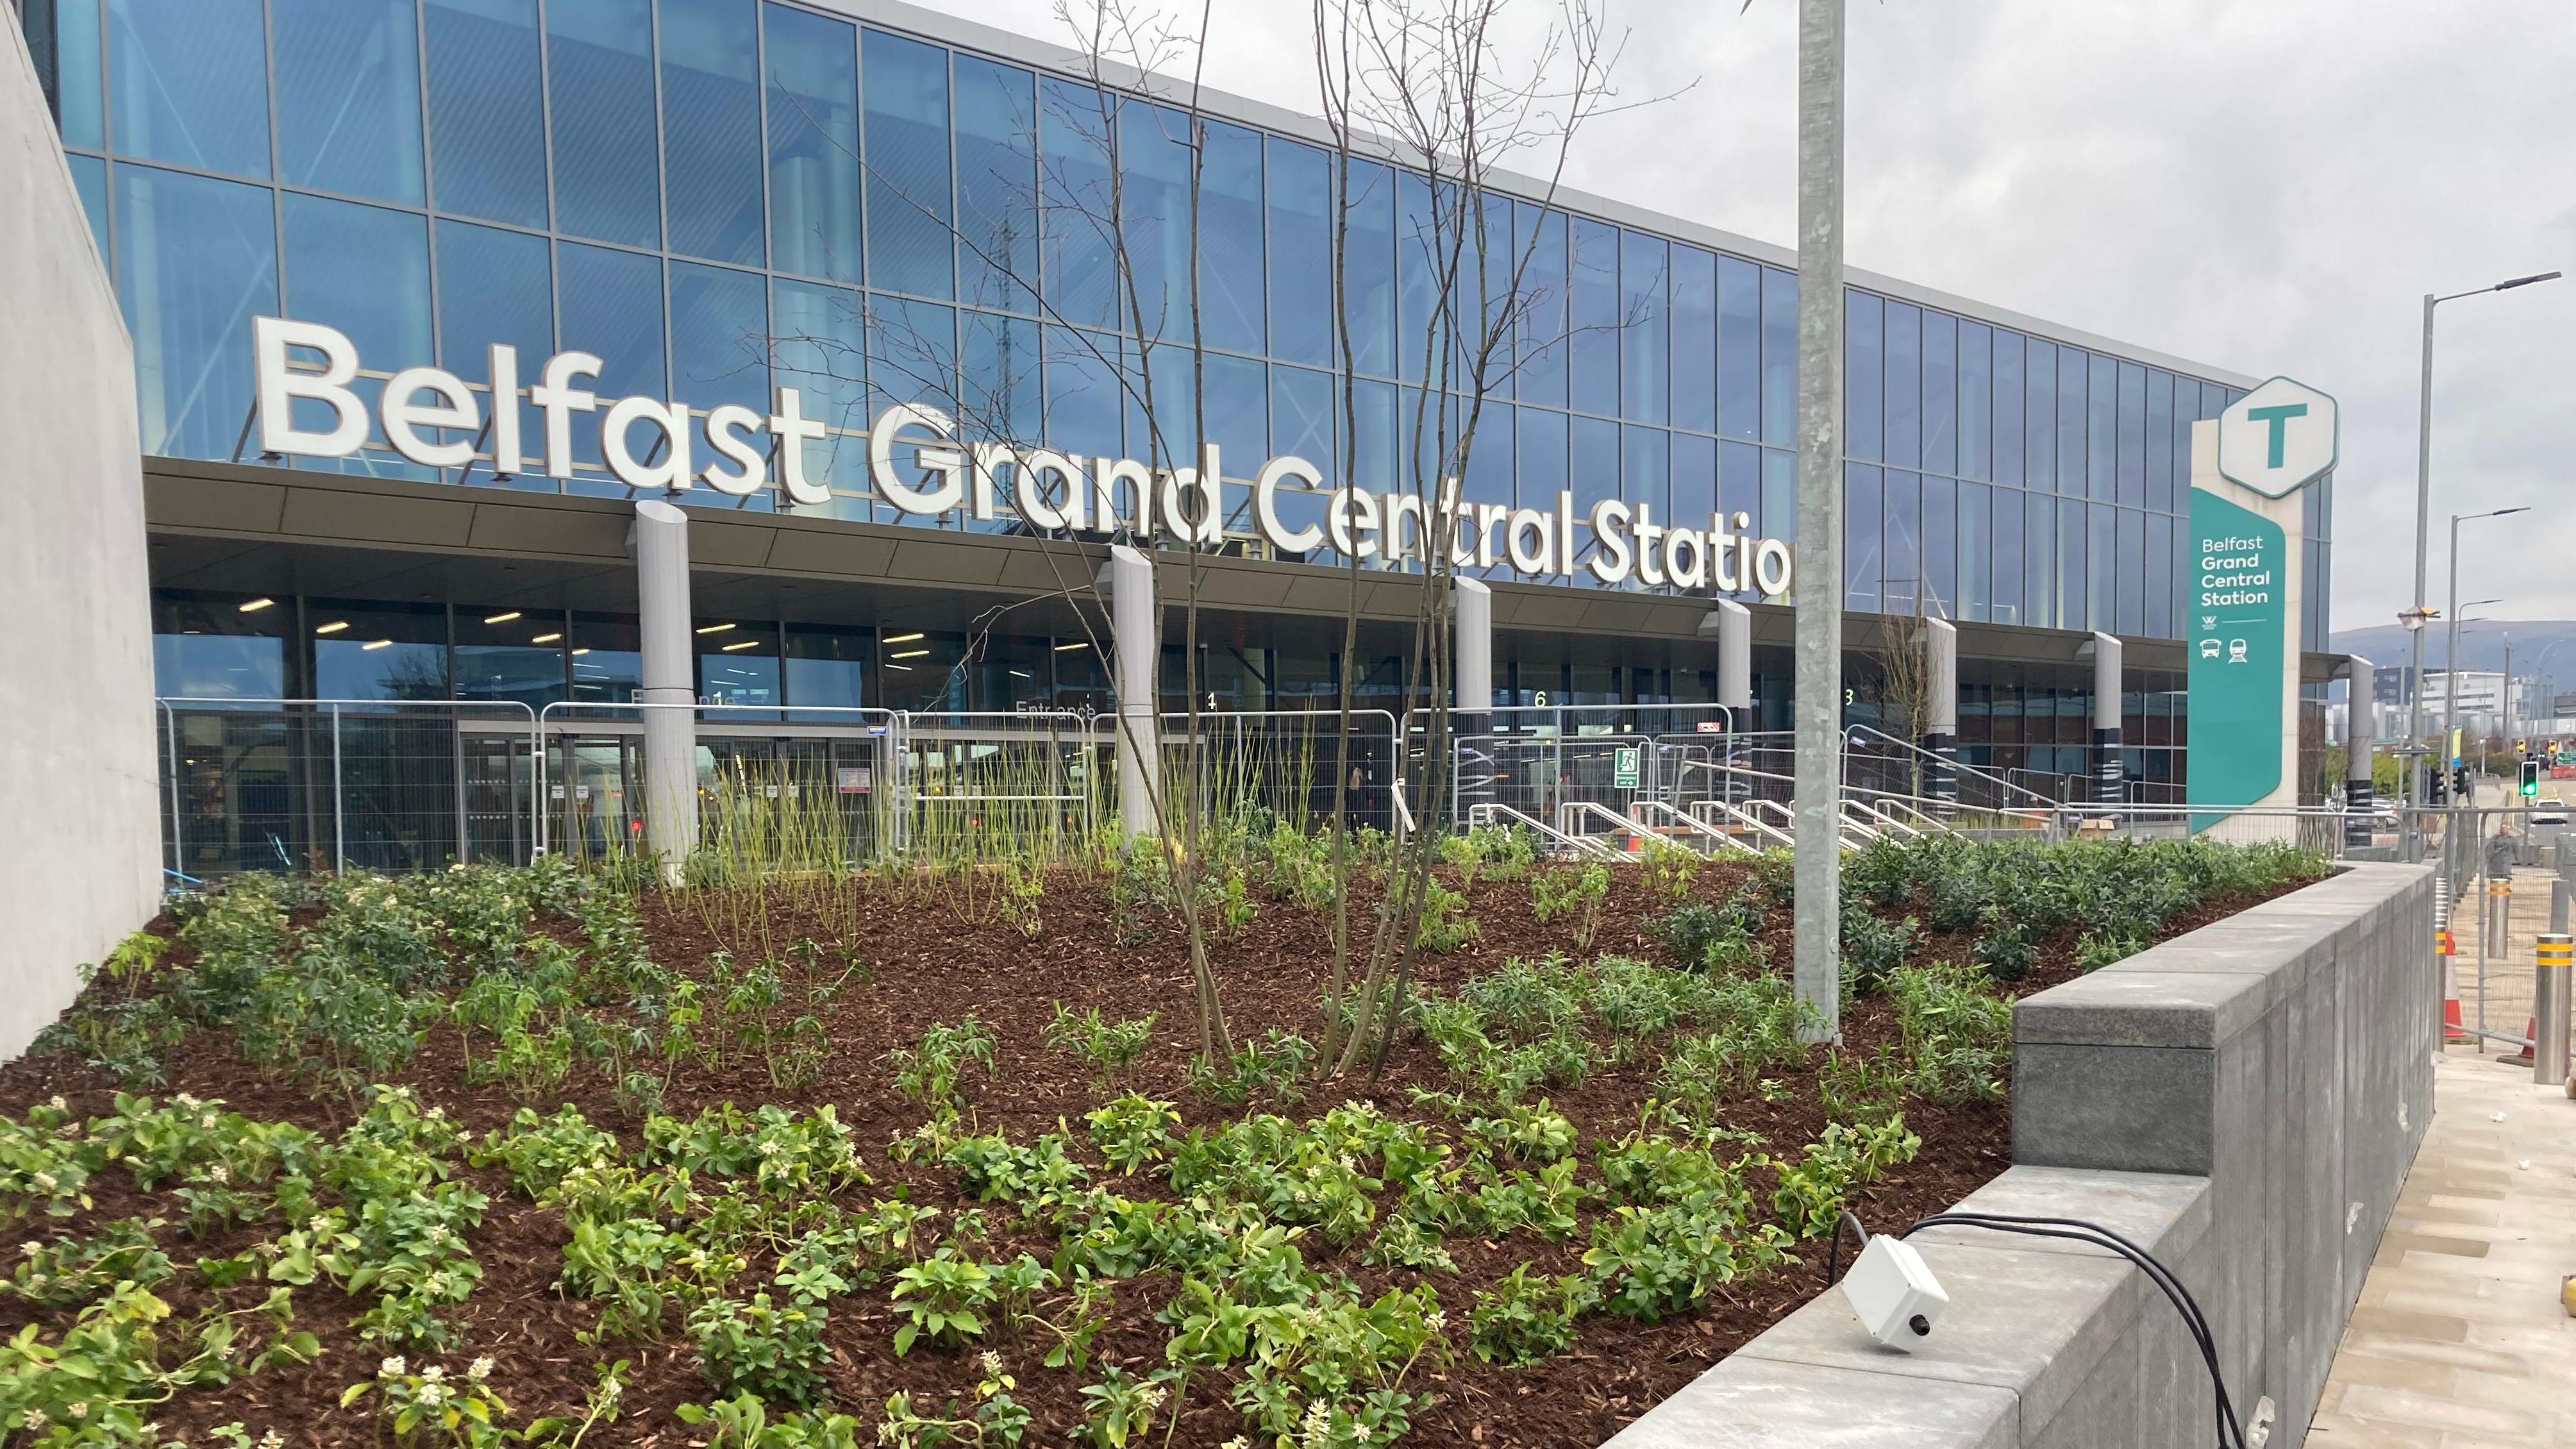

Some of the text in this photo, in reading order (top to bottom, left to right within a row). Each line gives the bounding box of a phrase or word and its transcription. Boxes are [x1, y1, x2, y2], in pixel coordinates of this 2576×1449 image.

[2248, 403, 2307, 469] T
[253, 316, 1797, 596] Belfast Grand Central Statio
[2202, 536, 2263, 553] Belfast
[2202, 553, 2259, 571] Grand
[2202, 571, 2270, 588] Central
[2201, 590, 2268, 607] Station
[1534, 691, 1546, 708] 6
